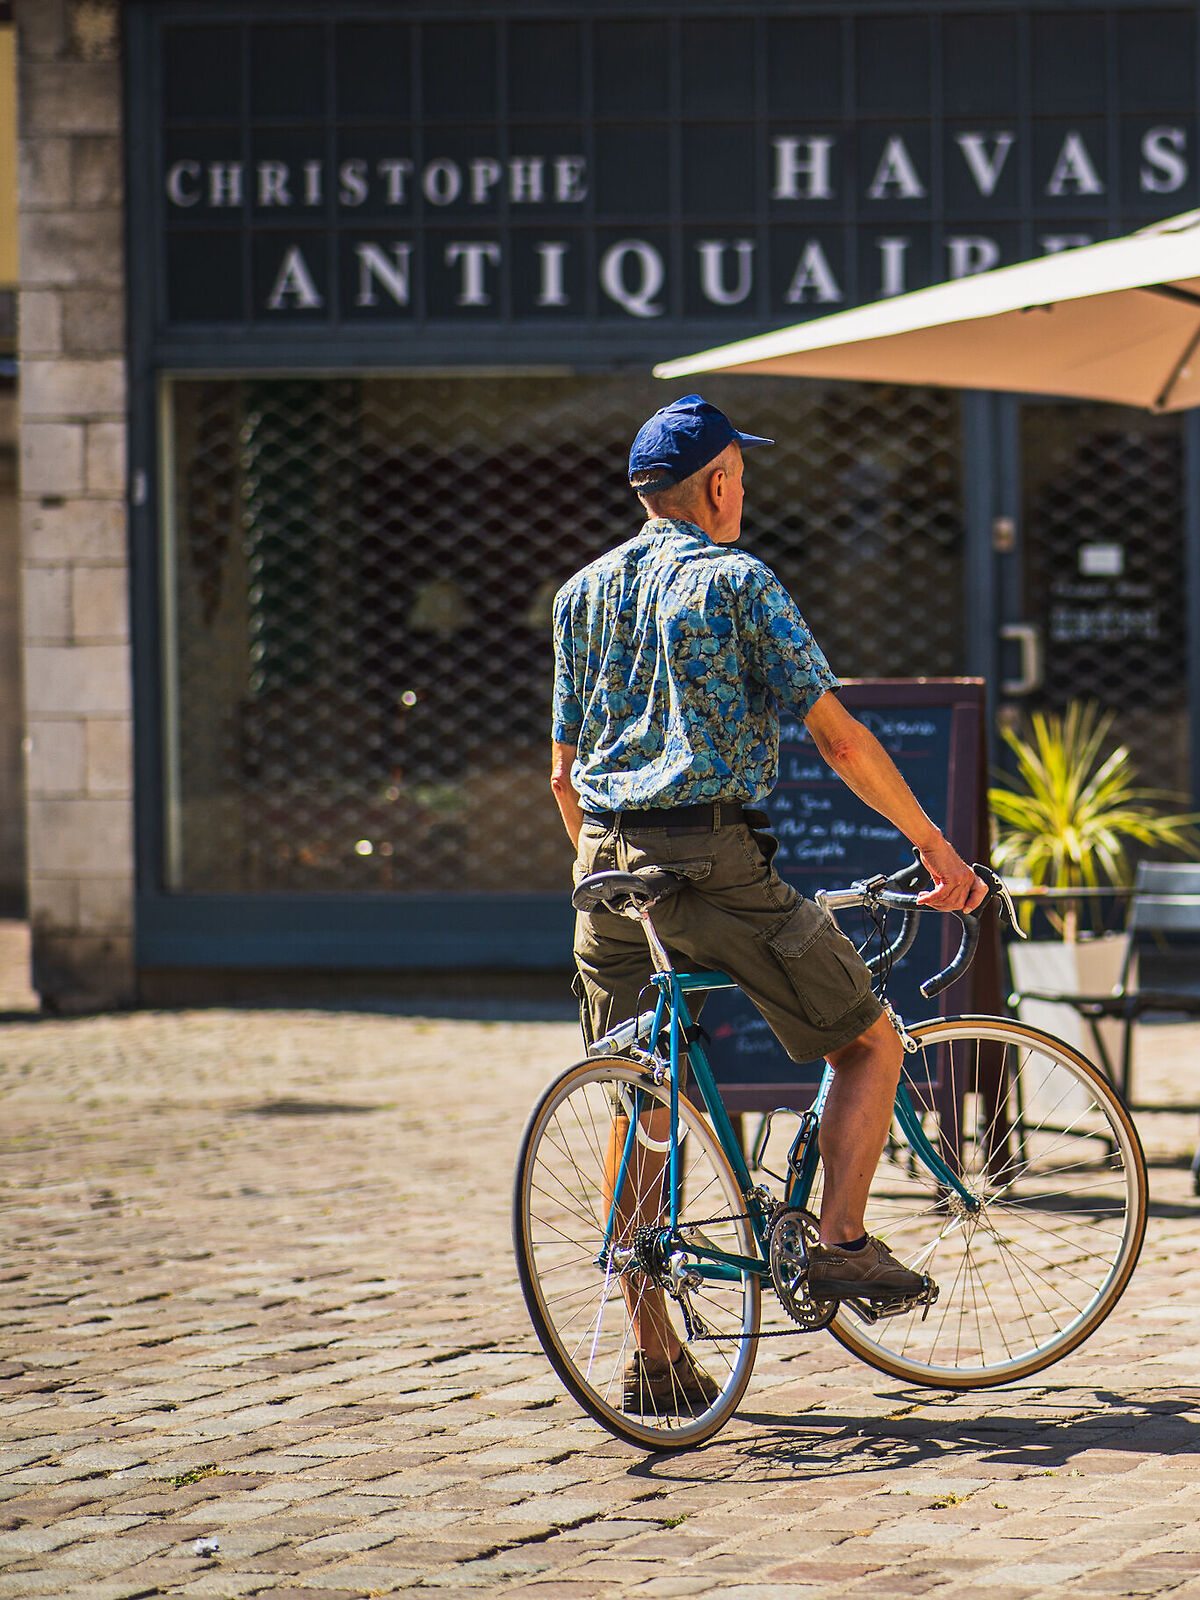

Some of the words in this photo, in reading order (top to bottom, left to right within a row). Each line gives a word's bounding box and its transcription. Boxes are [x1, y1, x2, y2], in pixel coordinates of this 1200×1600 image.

[166, 154, 589, 207] CHRISTOPHE
[771, 124, 1189, 201] HAVAS
[268, 233, 1093, 317] ANTIQUAIR
